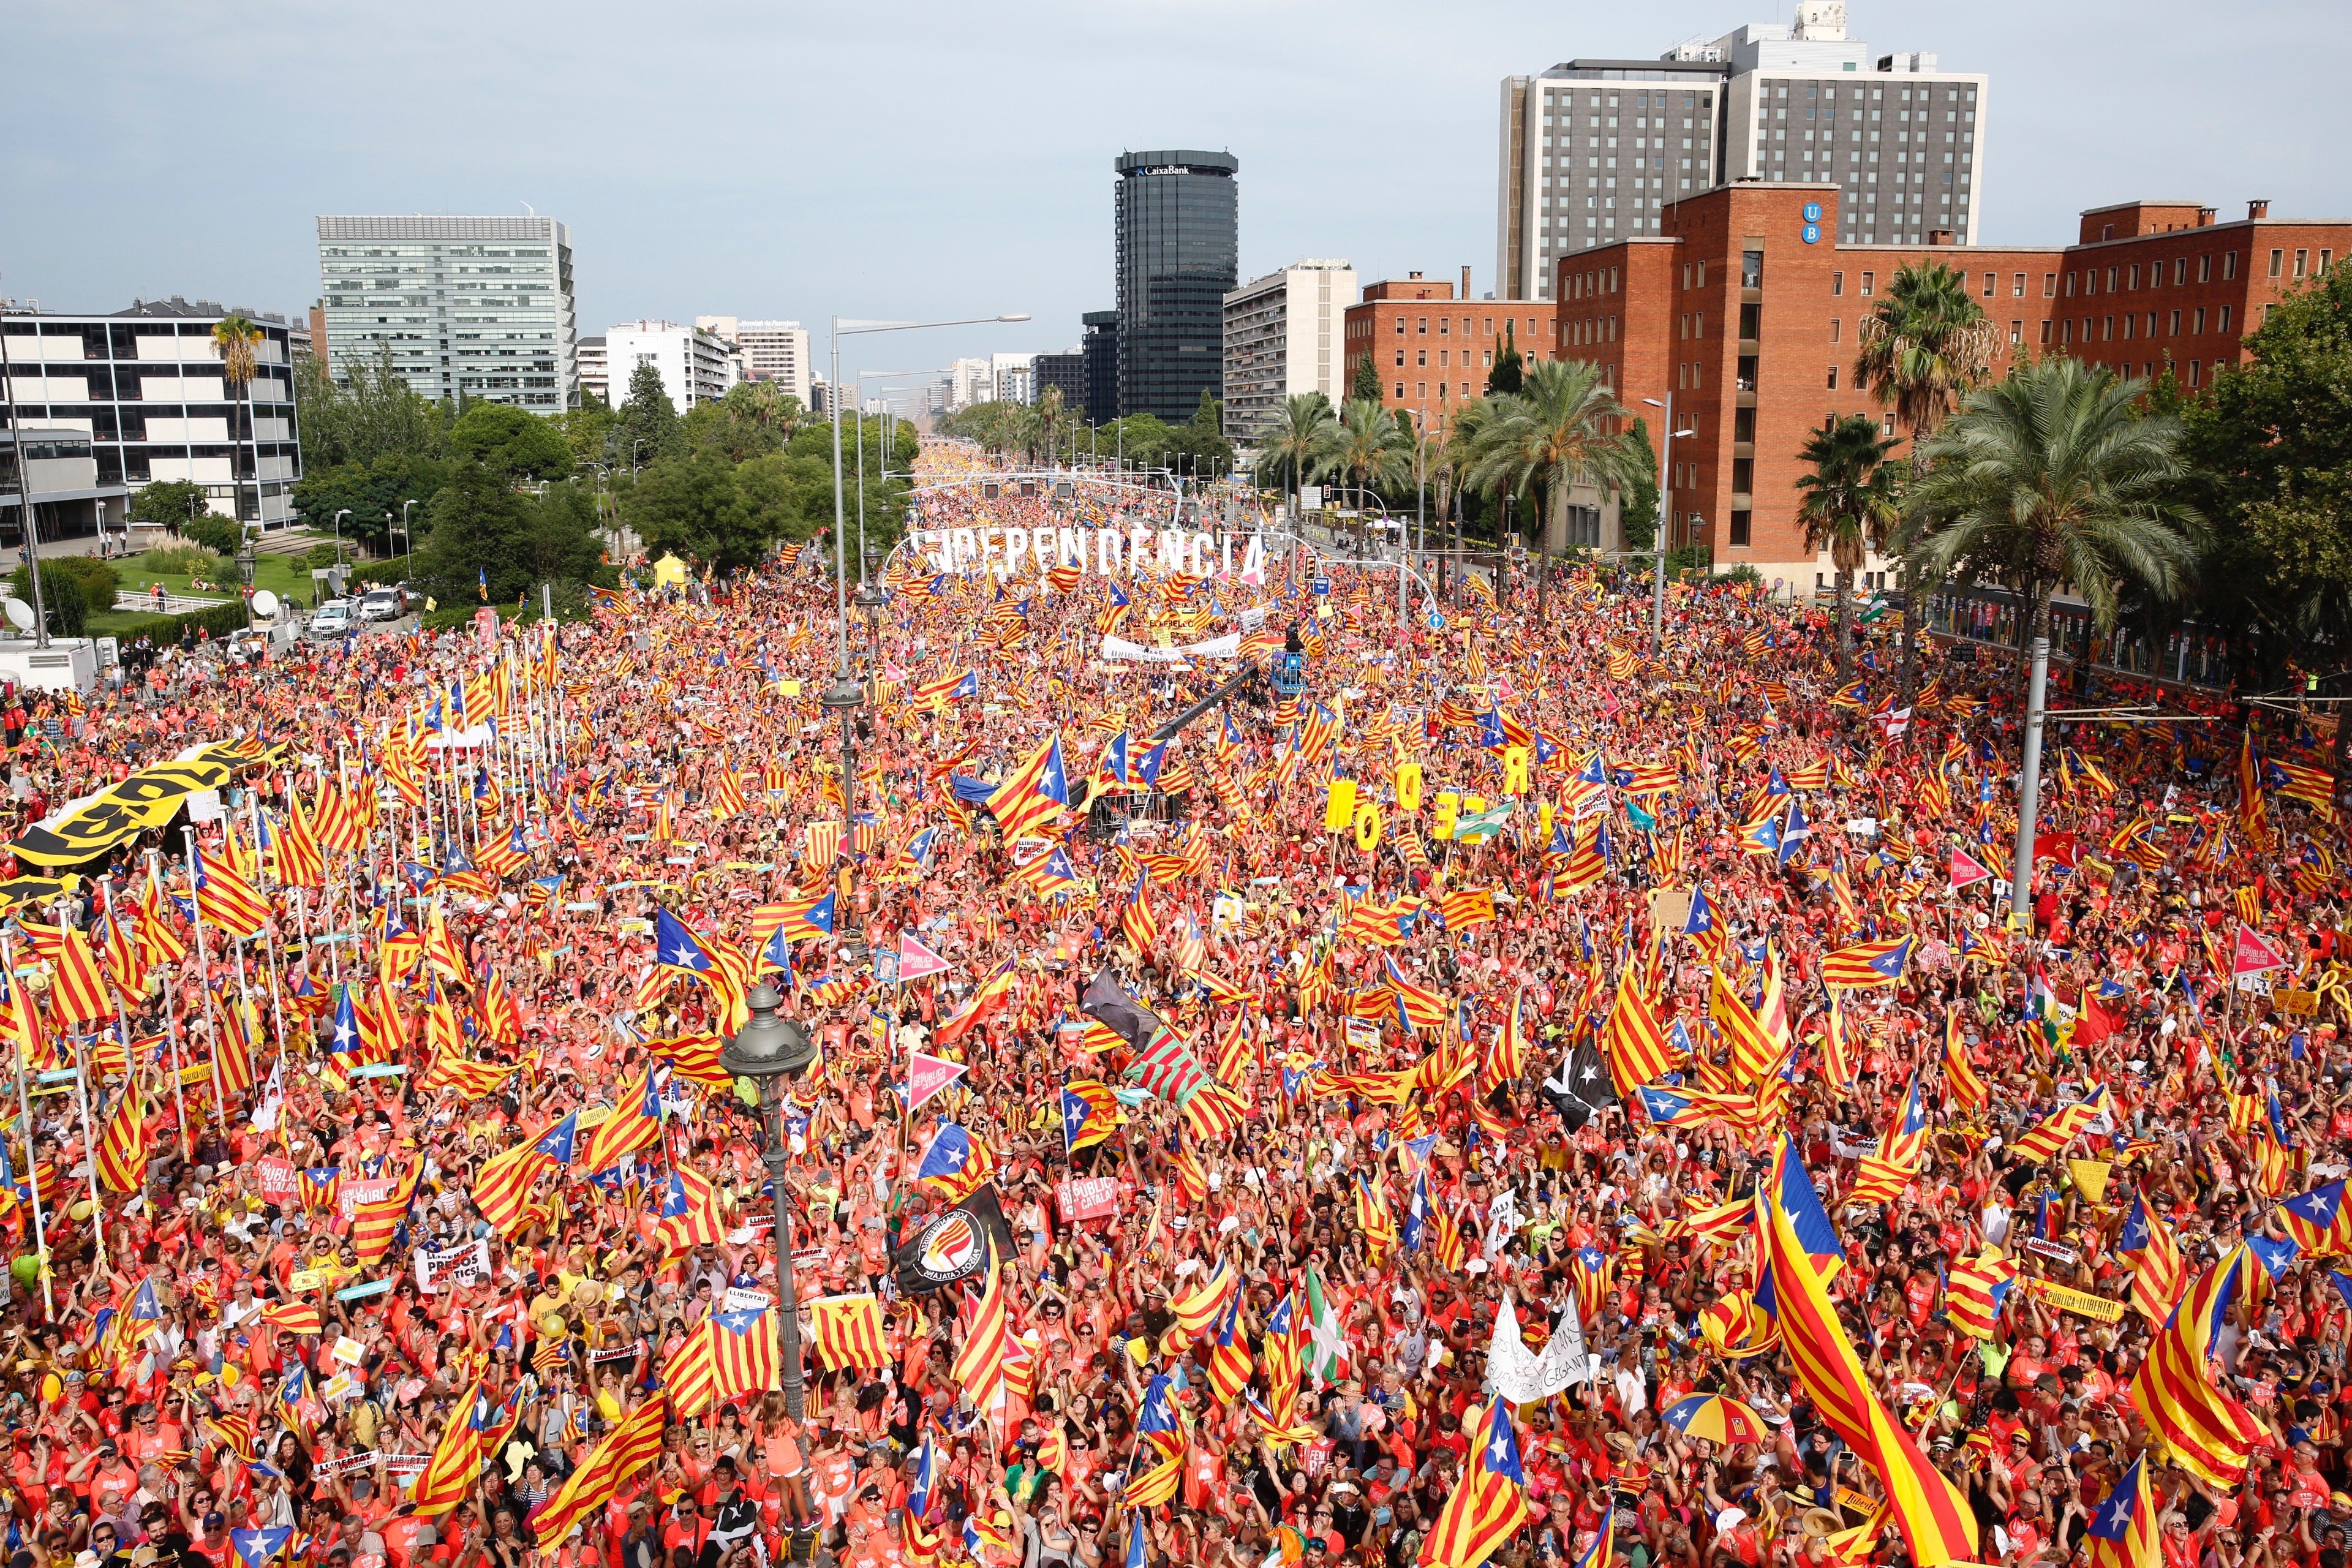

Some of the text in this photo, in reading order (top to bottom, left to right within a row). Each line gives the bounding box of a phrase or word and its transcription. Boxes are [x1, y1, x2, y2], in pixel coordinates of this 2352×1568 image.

[1145, 165, 1189, 175] CaixaBank
[1807, 207, 1818, 219] U
[1807, 228, 1816, 239] B
[1306, 258, 1349, 268] OCASO
[903, 955, 933, 963] REPÚBLICA
[2239, 948, 2268, 959] REPÚBLICA
[2246, 957, 2268, 966] CATALANA
[913, 1066, 946, 1089] REPÚBLICA
[922, 1075, 946, 1091] CATALANA
[584, 1107, 609, 1125] LLIBERTAT
[341, 1185, 364, 1199] FEM LA
[2032, 1238, 2070, 1256] LLIBERTAT
[428, 1253, 478, 1272] PRESOS
[341, 1281, 390, 1298] #SomRepública
[729, 1290, 766, 1303] LLIBERTAT
[2040, 1289, 2075, 1308] REPÚBLICA
[2078, 1297, 2117, 1315] LLIBERTAT
[595, 1343, 639, 1357] LLIBERTAT
[331, 1376, 343, 1387] FREE
[327, 1381, 349, 1397] CATALONIA
[1310, 1450, 1325, 1460] FEM
